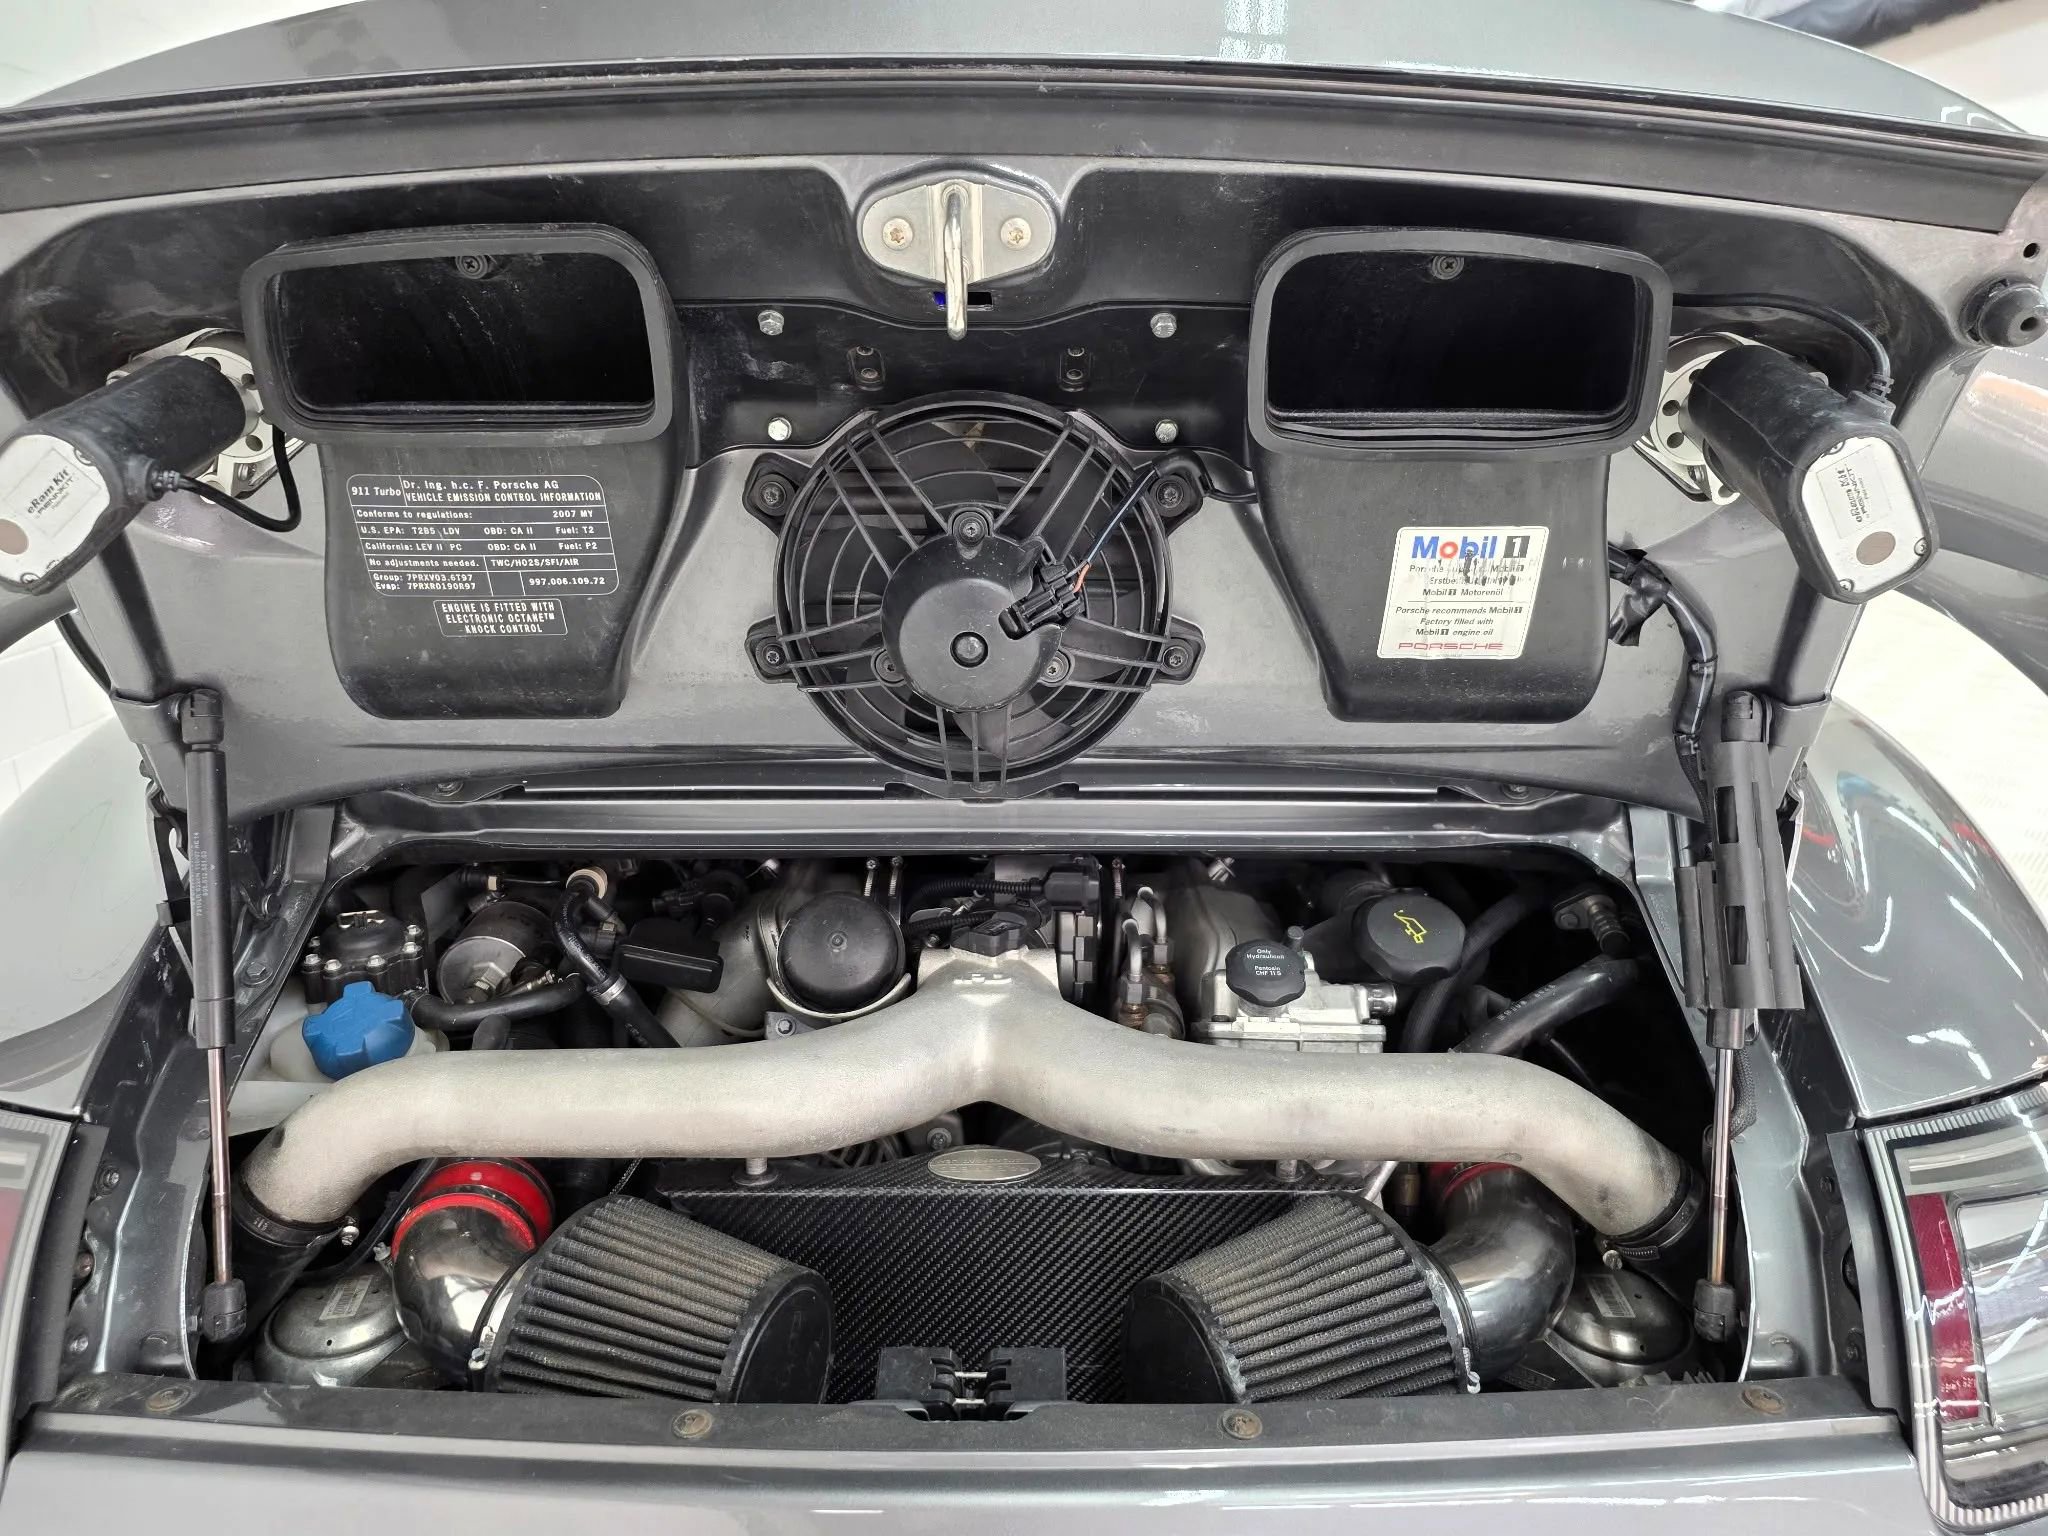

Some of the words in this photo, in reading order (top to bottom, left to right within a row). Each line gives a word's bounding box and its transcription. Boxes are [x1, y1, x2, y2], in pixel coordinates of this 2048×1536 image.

[402, 480, 420, 489] Dr.
[425, 480, 447, 490] Ing.
[451, 480, 473, 489] h.c.
[477, 480, 489, 489] F.
[493, 480, 539, 489] Porsche
[544, 480, 559, 489] AG
[28, 486, 54, 513] eRam
[53, 468, 69, 486] Kit
[351, 487, 370, 496] 911
[373, 487, 401, 496] Turbo
[405, 492, 444, 502] VEHICLE
[446, 492, 492, 502] EMISSION
[494, 492, 537, 502] CONTROL
[540, 492, 601, 501] INFORMATION
[356, 509, 400, 518] Conforms
[403, 509, 413, 518] to
[416, 510, 473, 519] regulations:
[552, 510, 576, 518] 2007
[580, 510, 593, 518] MY
[360, 526, 381, 534] U.S.
[383, 526, 405, 534] EPA:
[411, 526, 436, 535] T2B5
[442, 527, 460, 535] LDV
[483, 527, 507, 535] OBD:
[510, 527, 524, 535] CA
[555, 526, 579, 534] Fuel:
[582, 526, 595, 534] T2
[365, 542, 413, 551] California:
[416, 543, 433, 551] LEV
[450, 543, 462, 551] PC
[487, 543, 511, 551] OBD:
[513, 543, 527, 551] CA
[558, 542, 582, 550] Fuel:
[585, 542, 598, 550] P2
[1411, 535, 1498, 560] Mobil
[369, 558, 381, 566] No
[384, 558, 440, 567] adjustments
[443, 559, 480, 567] needed.
[373, 573, 403, 582] Group:
[375, 582, 400, 590] Evap:
[1461, 588, 1504, 596] Motorenöl
[441, 603, 477, 613] ENGINE
[480, 603, 491, 612] IS
[494, 602, 527, 612] FITTED
[530, 601, 555, 611] WITH
[1395, 606, 1430, 614] Porsche
[445, 614, 504, 624] ELECTRONIC
[1420, 617, 1453, 626] Factory
[1454, 617, 1475, 625] filled
[1477, 617, 1494, 625] with
[465, 624, 497, 634] KNOCK
[500, 623, 543, 633] CONTROL
[1452, 629, 1481, 637] engine
[1483, 628, 1494, 636] oil
[1398, 642, 1504, 651] PORSCHE
